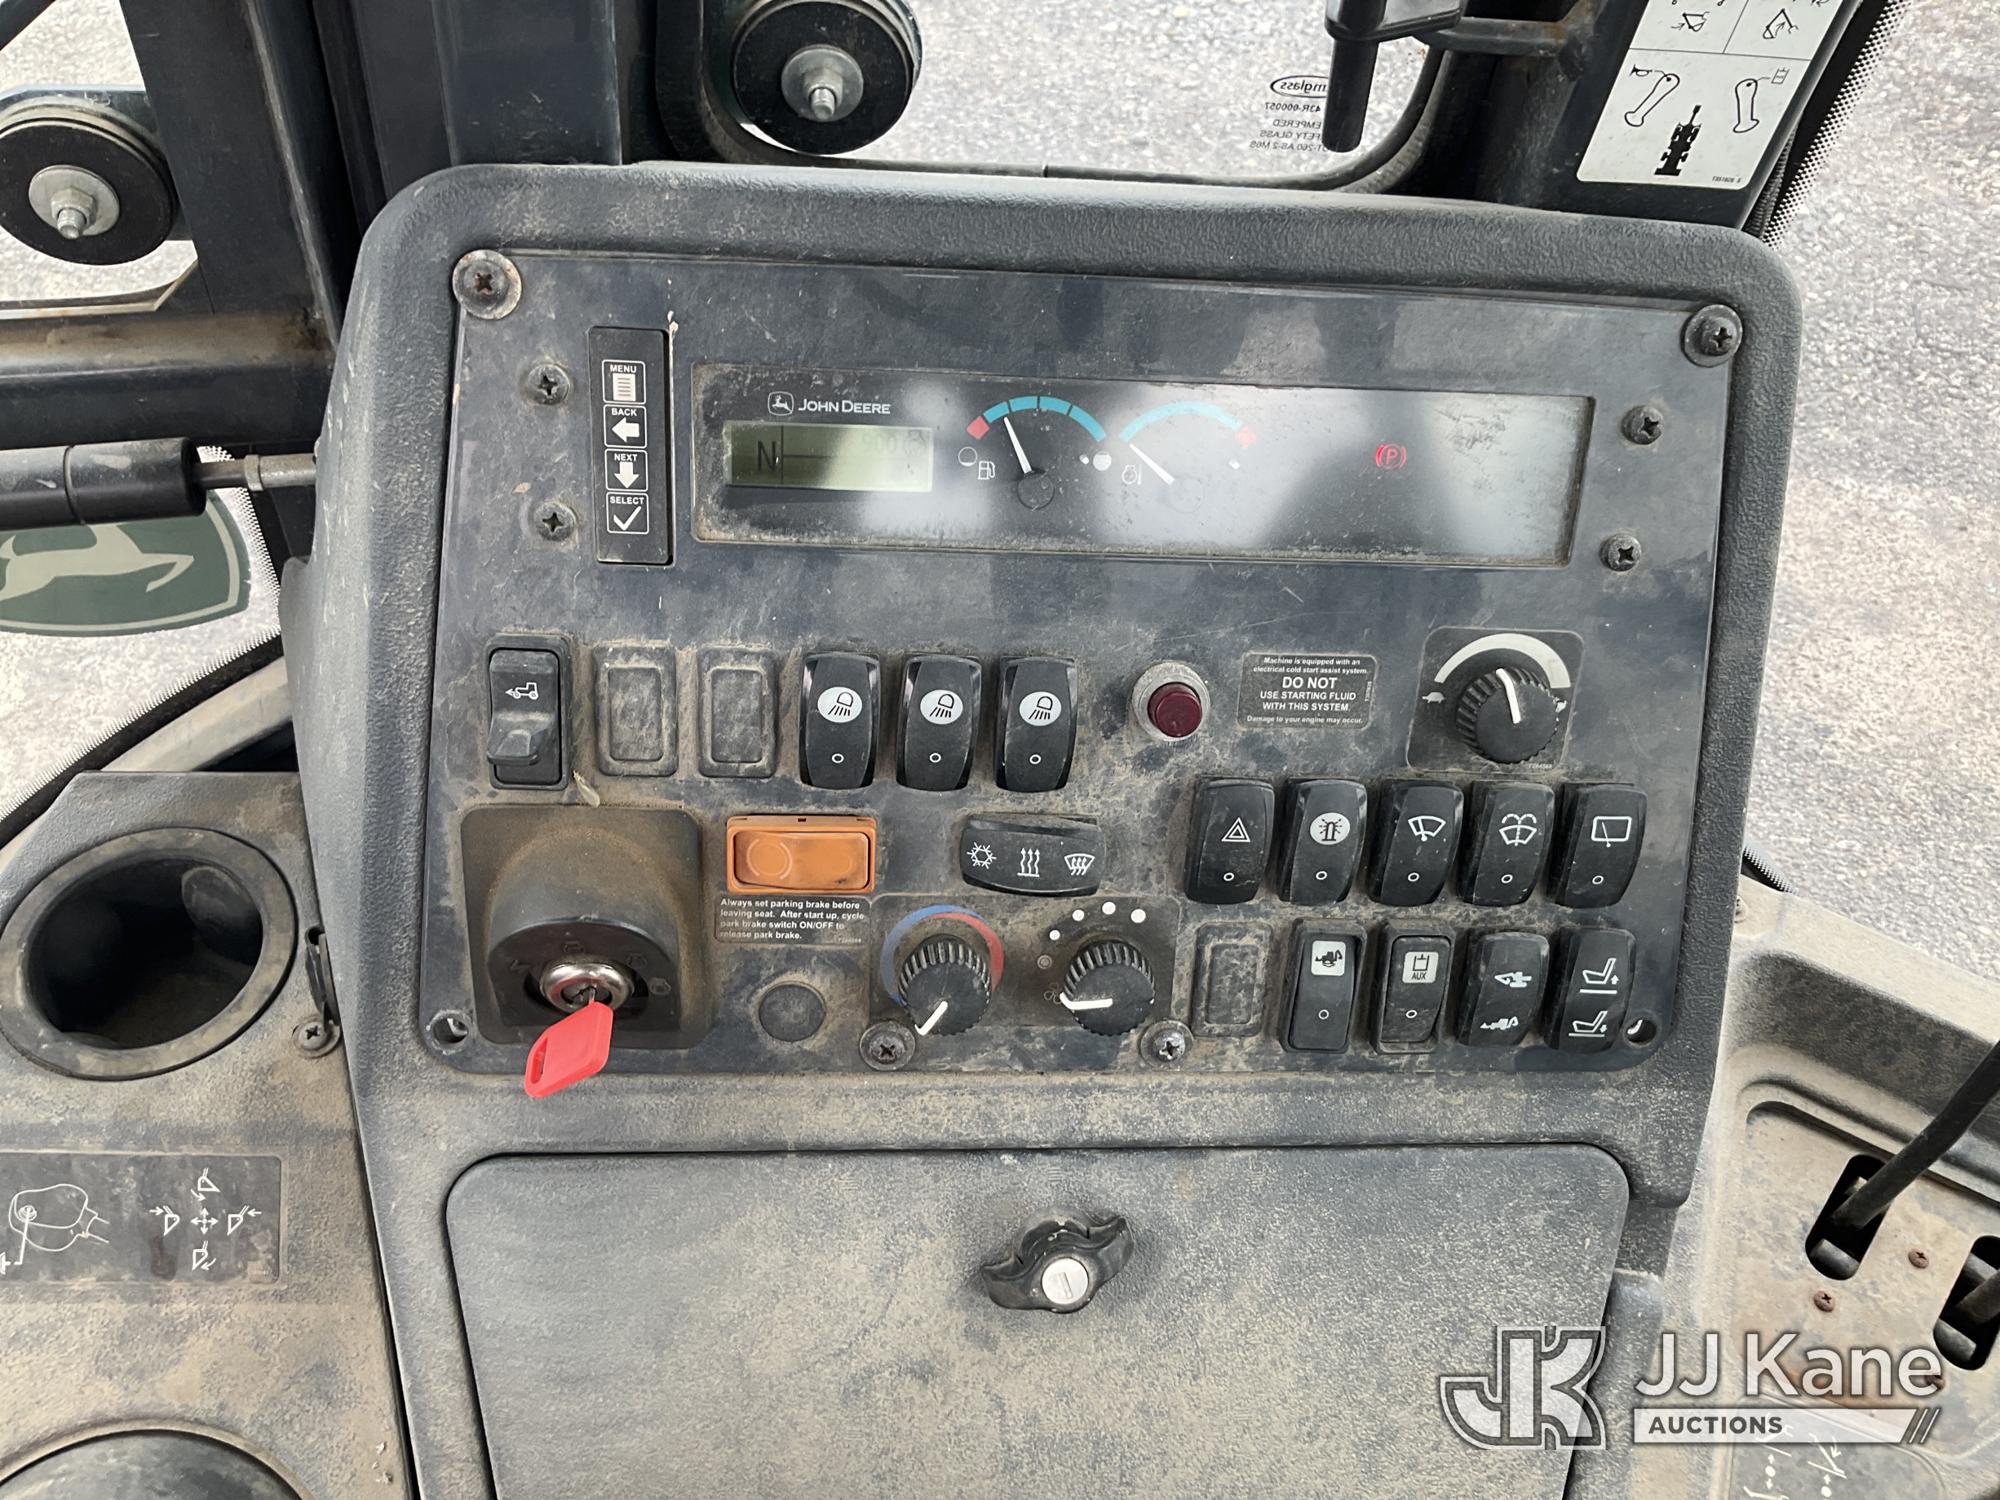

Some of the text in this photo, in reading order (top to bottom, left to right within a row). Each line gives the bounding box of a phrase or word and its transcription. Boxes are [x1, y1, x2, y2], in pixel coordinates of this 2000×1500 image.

[610, 365, 637, 373] MENU
[798, 399, 891, 414] JOHN DEERE
[612, 408, 637, 416] BACK
[757, 440, 776, 471] N
[610, 496, 644, 505] SELECT
[1282, 677, 1337, 688] DO NOT
[1260, 691, 1356, 700] USE STARTING FLUID
[1263, 702, 1286, 710] WITH
[1289, 702, 1309, 710] THIS
[720, 899, 752, 908] Always
[771, 900, 803, 909] parking
[832, 901, 860, 909] before
[721, 910, 752, 918] leaving
[842, 913, 864, 921] cycle
[769, 921, 797, 929] switch
[754, 931, 773, 939] park
[776, 931, 802, 939] brake.
[1411, 972, 1427, 981] AUX
